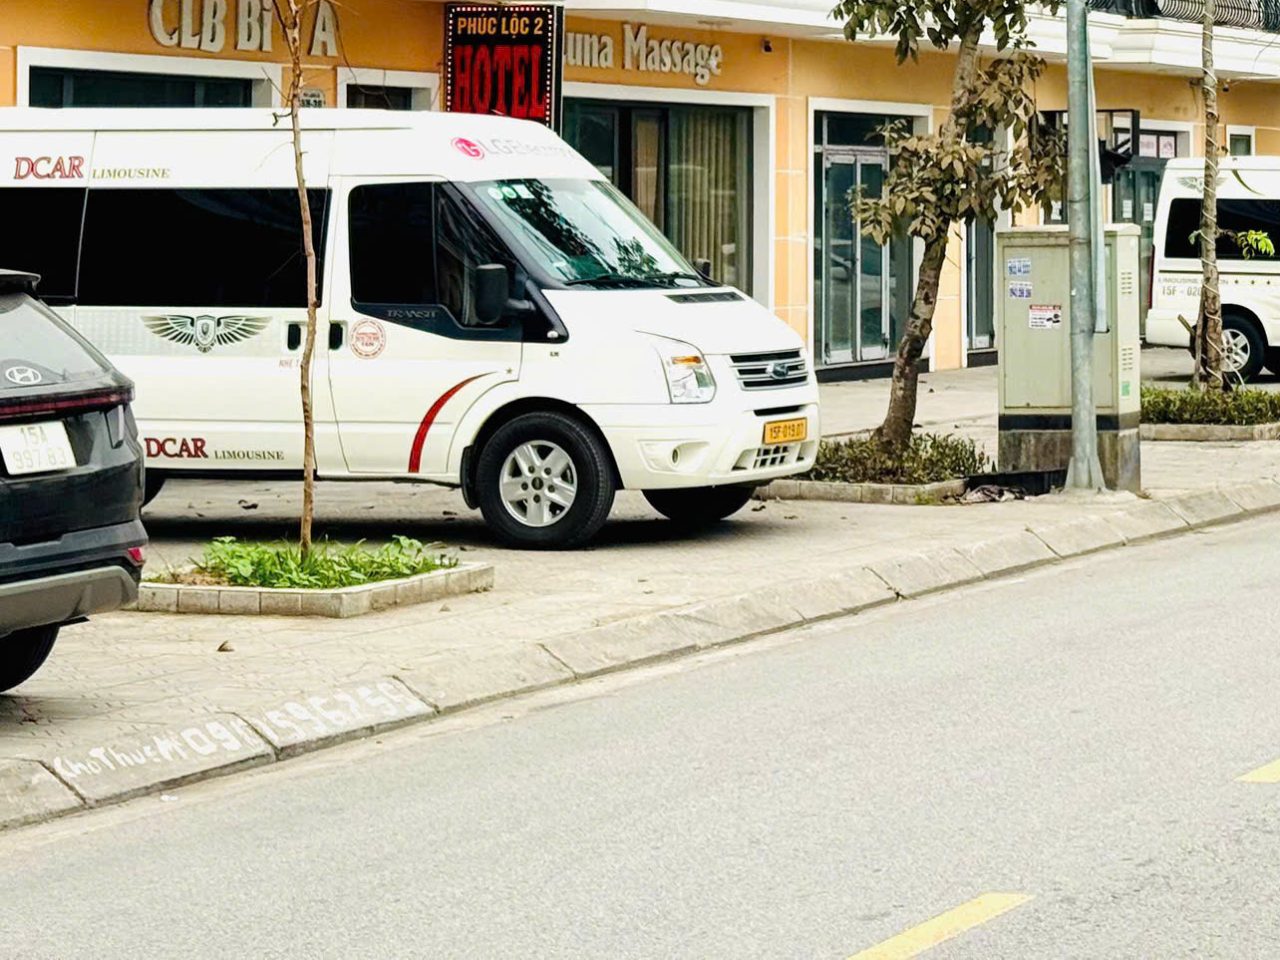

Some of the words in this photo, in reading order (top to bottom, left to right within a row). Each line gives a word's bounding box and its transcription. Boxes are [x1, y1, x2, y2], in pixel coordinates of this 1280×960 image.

[456, 15, 497, 36] PHÚC
[502, 16, 530, 39] LỘC
[533, 17, 544, 36] 2
[563, 29, 614, 69] una
[623, 23, 722, 86] Massage
[453, 43, 546, 119] HOTEL
[14, 156, 85, 180] DCAR
[91, 168, 170, 180] LIMOUSINE
[144, 438, 209, 459] DCAR
[214, 450, 284, 460] LIMOUSINE
